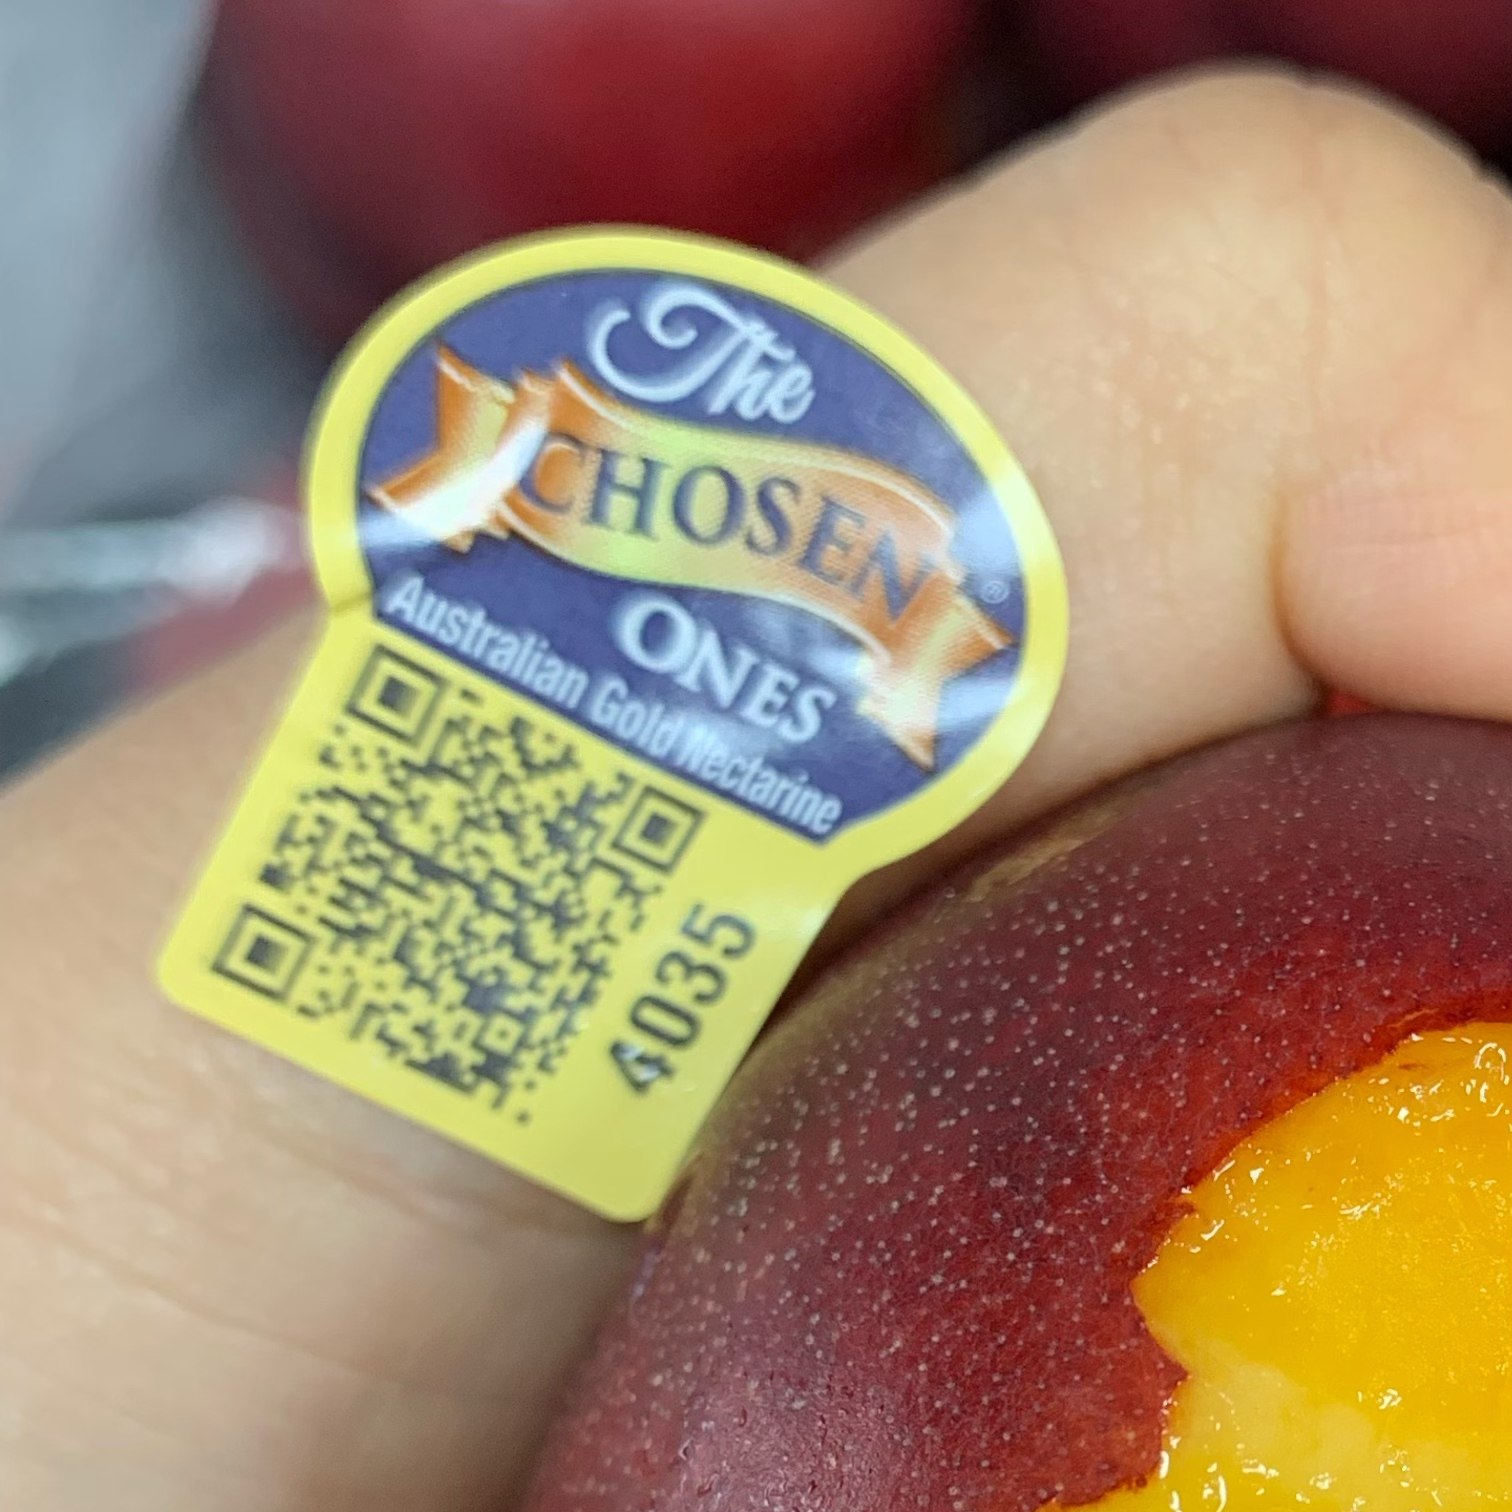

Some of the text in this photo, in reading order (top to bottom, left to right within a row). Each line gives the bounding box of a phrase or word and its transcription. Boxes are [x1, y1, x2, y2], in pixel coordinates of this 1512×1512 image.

[588, 281, 815, 425] The
[517, 432, 936, 620] CHOSEN
[383, 576, 844, 835] Australian Gold Nectarine
[614, 595, 837, 744] ONES
[609, 902, 757, 1093] 4035
